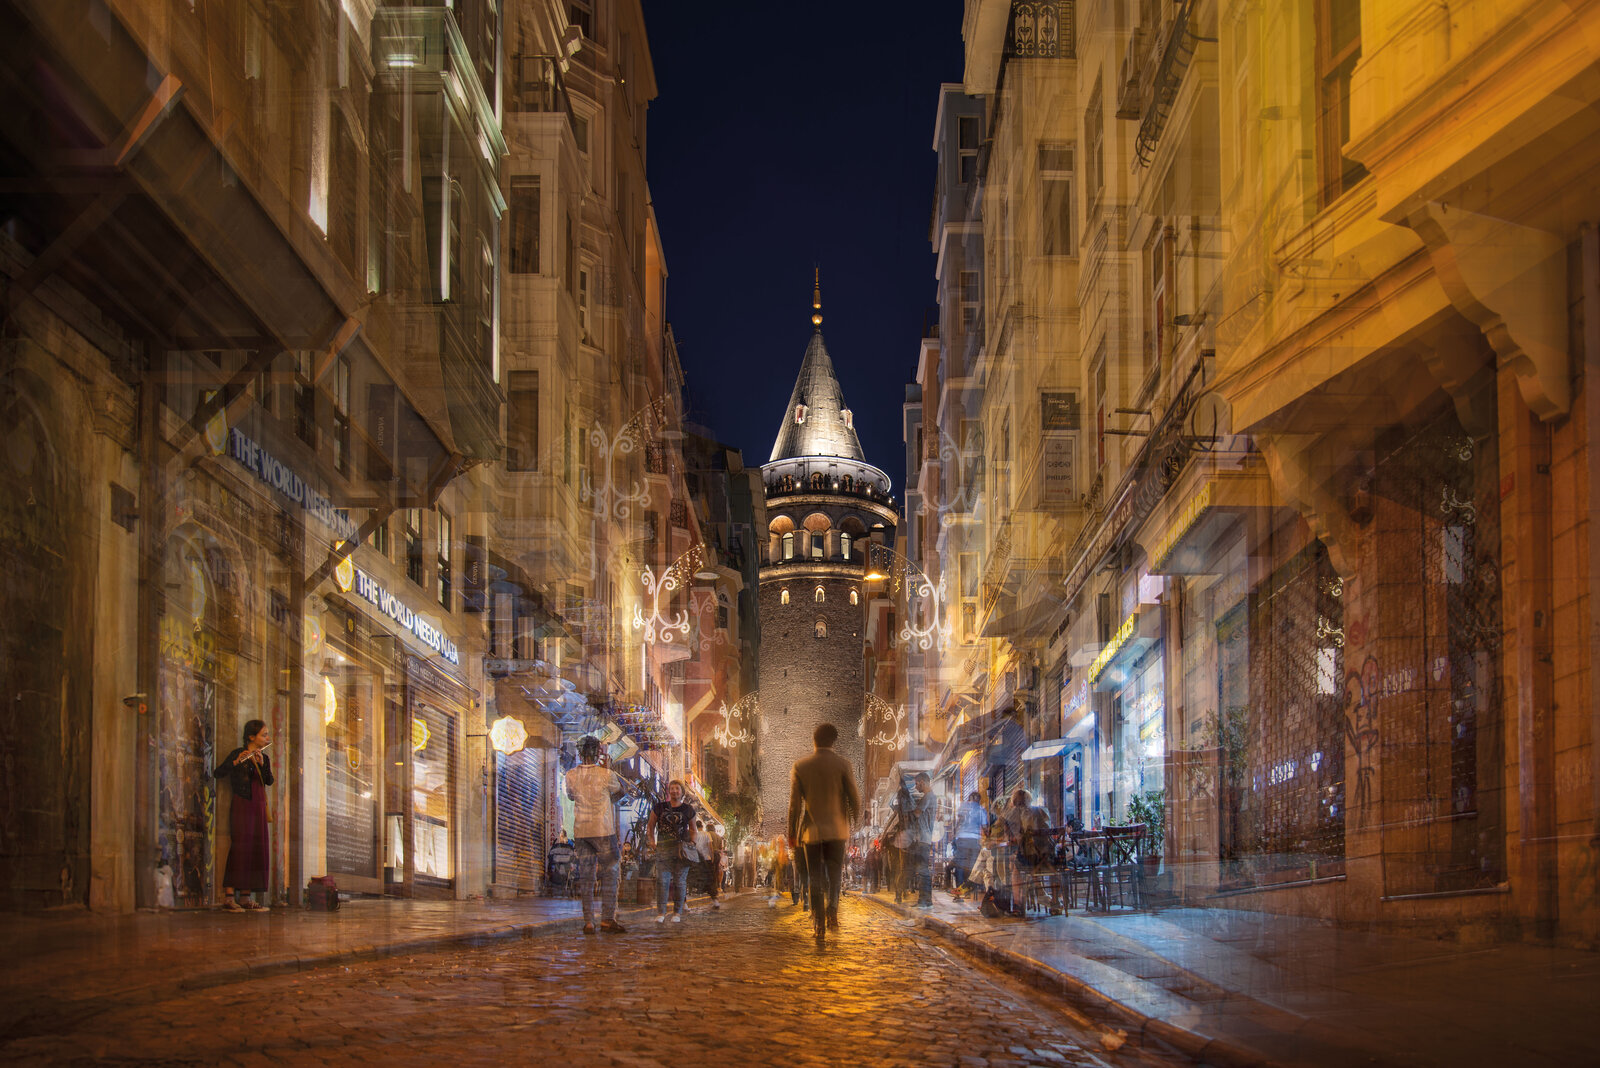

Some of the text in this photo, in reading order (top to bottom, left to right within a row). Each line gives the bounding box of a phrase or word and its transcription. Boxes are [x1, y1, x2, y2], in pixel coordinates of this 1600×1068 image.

[232, 427, 259, 472] THE
[260, 449, 304, 502] WORLD
[304, 485, 338, 530] NEEDS
[356, 569, 378, 606] THE
[378, 587, 413, 632] WORLD
[413, 614, 441, 651] NEEDS
[441, 633, 460, 665] NATA
